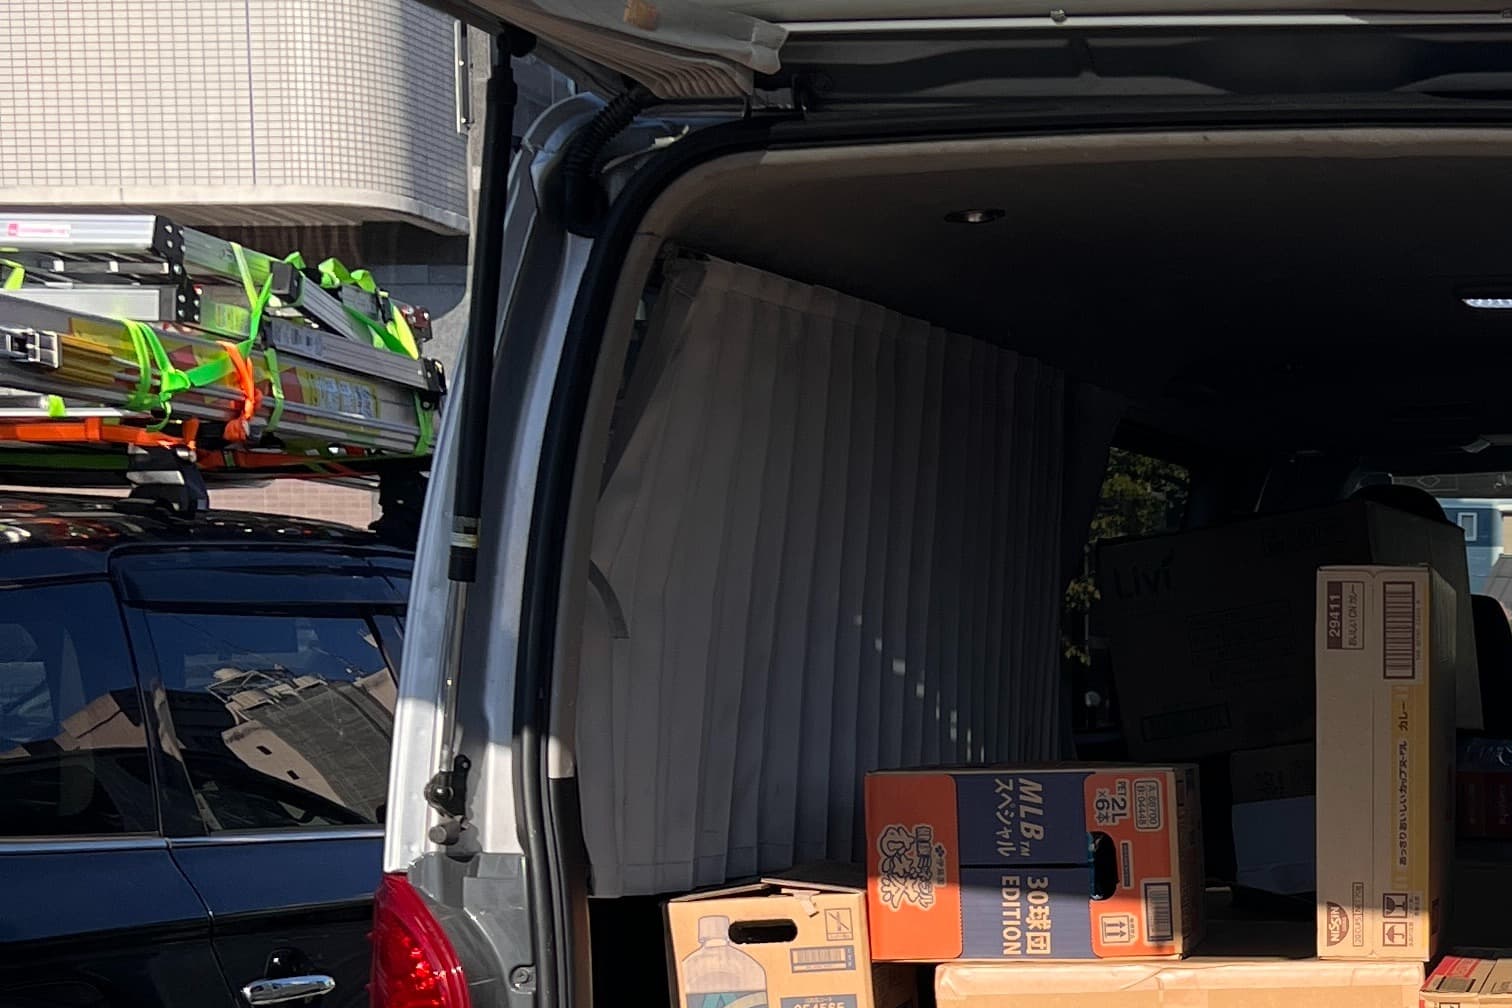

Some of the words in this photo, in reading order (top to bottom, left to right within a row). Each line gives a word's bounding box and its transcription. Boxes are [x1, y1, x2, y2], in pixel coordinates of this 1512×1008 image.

[1328, 594, 1341, 638] 29411
[994, 778, 1017, 857] スペシャル
[879, 826, 914, 910] むぎ茶
[1001, 875, 1022, 956] EDITION
[1025, 876, 1052, 955] 30球団
[1328, 906, 1342, 942] NISSIN
